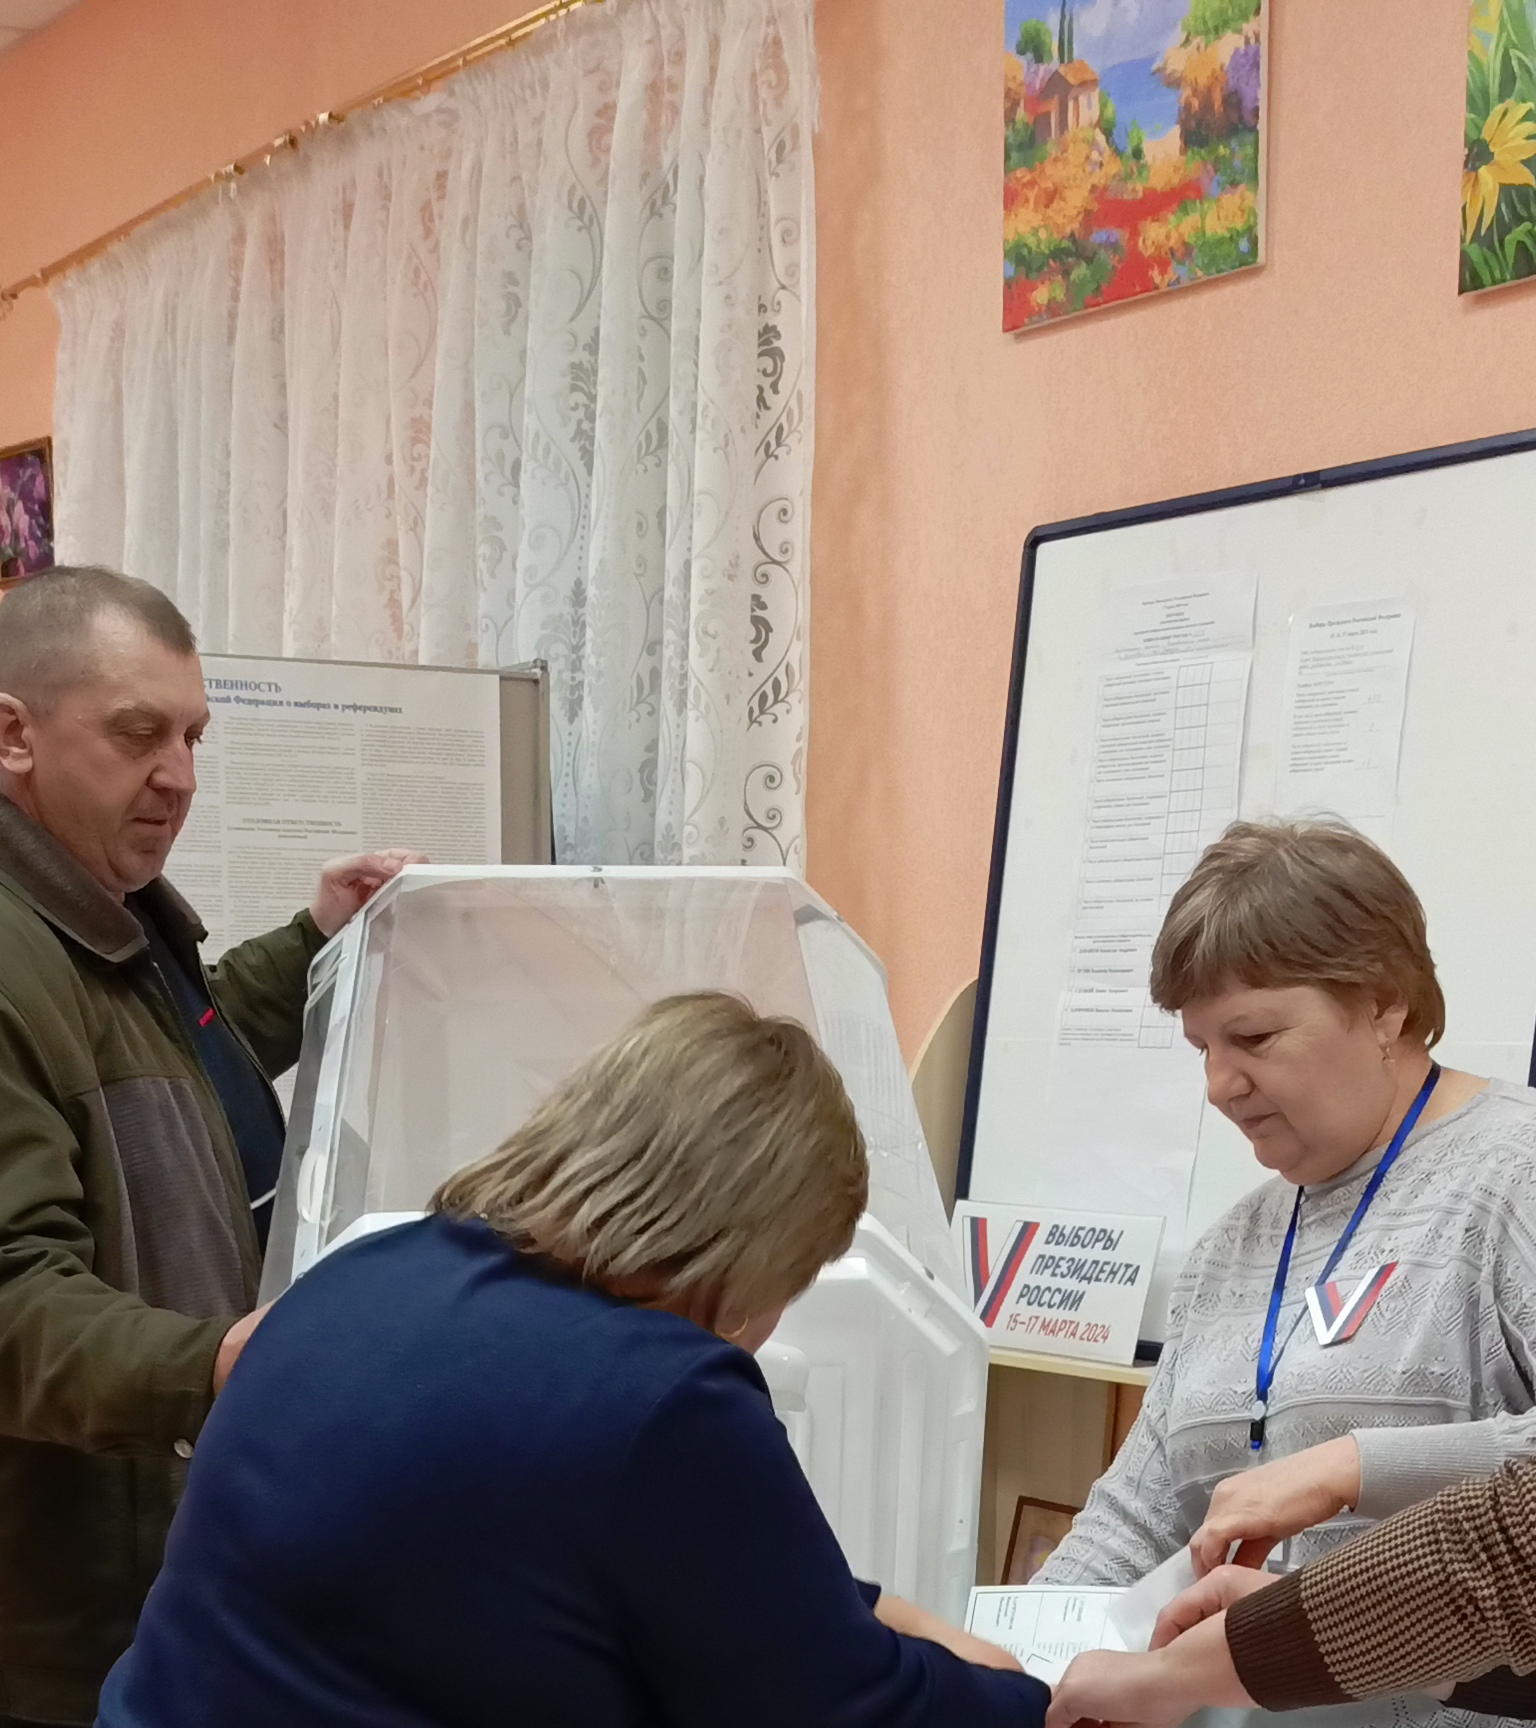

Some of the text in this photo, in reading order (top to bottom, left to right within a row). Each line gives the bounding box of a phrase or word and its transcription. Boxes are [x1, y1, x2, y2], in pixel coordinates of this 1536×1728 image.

[1044, 1224, 1124, 1251] ВЫБОРЫ
[1029, 1254, 1141, 1287] ПРЕЗИДЕНТА
[1015, 1284, 1086, 1312] РОССИИ
[1038, 1316, 1078, 1340] МАРТА
[1079, 1322, 1111, 1344] 2024
